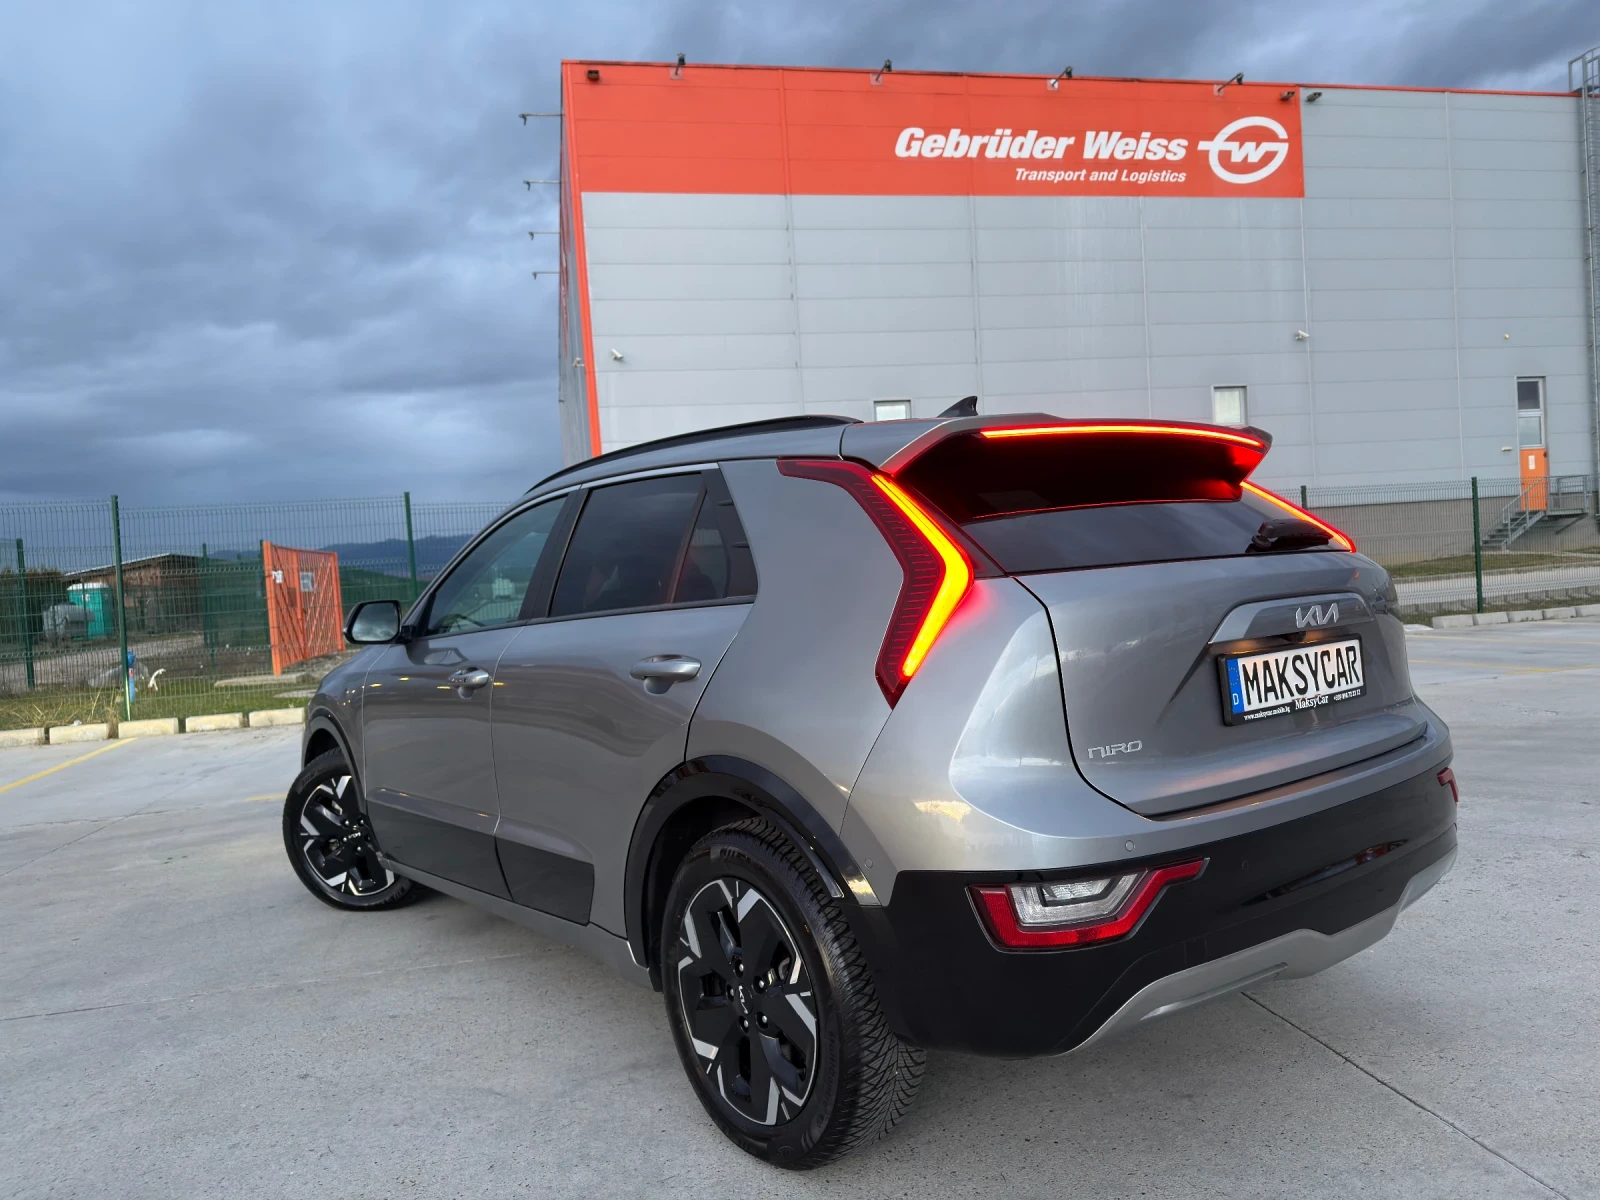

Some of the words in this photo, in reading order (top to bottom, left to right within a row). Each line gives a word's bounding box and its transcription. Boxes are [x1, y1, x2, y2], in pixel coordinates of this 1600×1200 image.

[894, 127, 1076, 159] Gebrüder
[1083, 131, 1189, 161] Weiss
[1015, 168, 1087, 183] Transport
[1089, 169, 1119, 182] and
[1121, 169, 1187, 184] Logistics
[1295, 603, 1339, 628] KIA
[1232, 693, 1240, 706] D
[1242, 646, 1360, 705] MAKSYCAR
[1294, 695, 1329, 710] MaksyCar
[1087, 740, 1143, 759] NIRO
